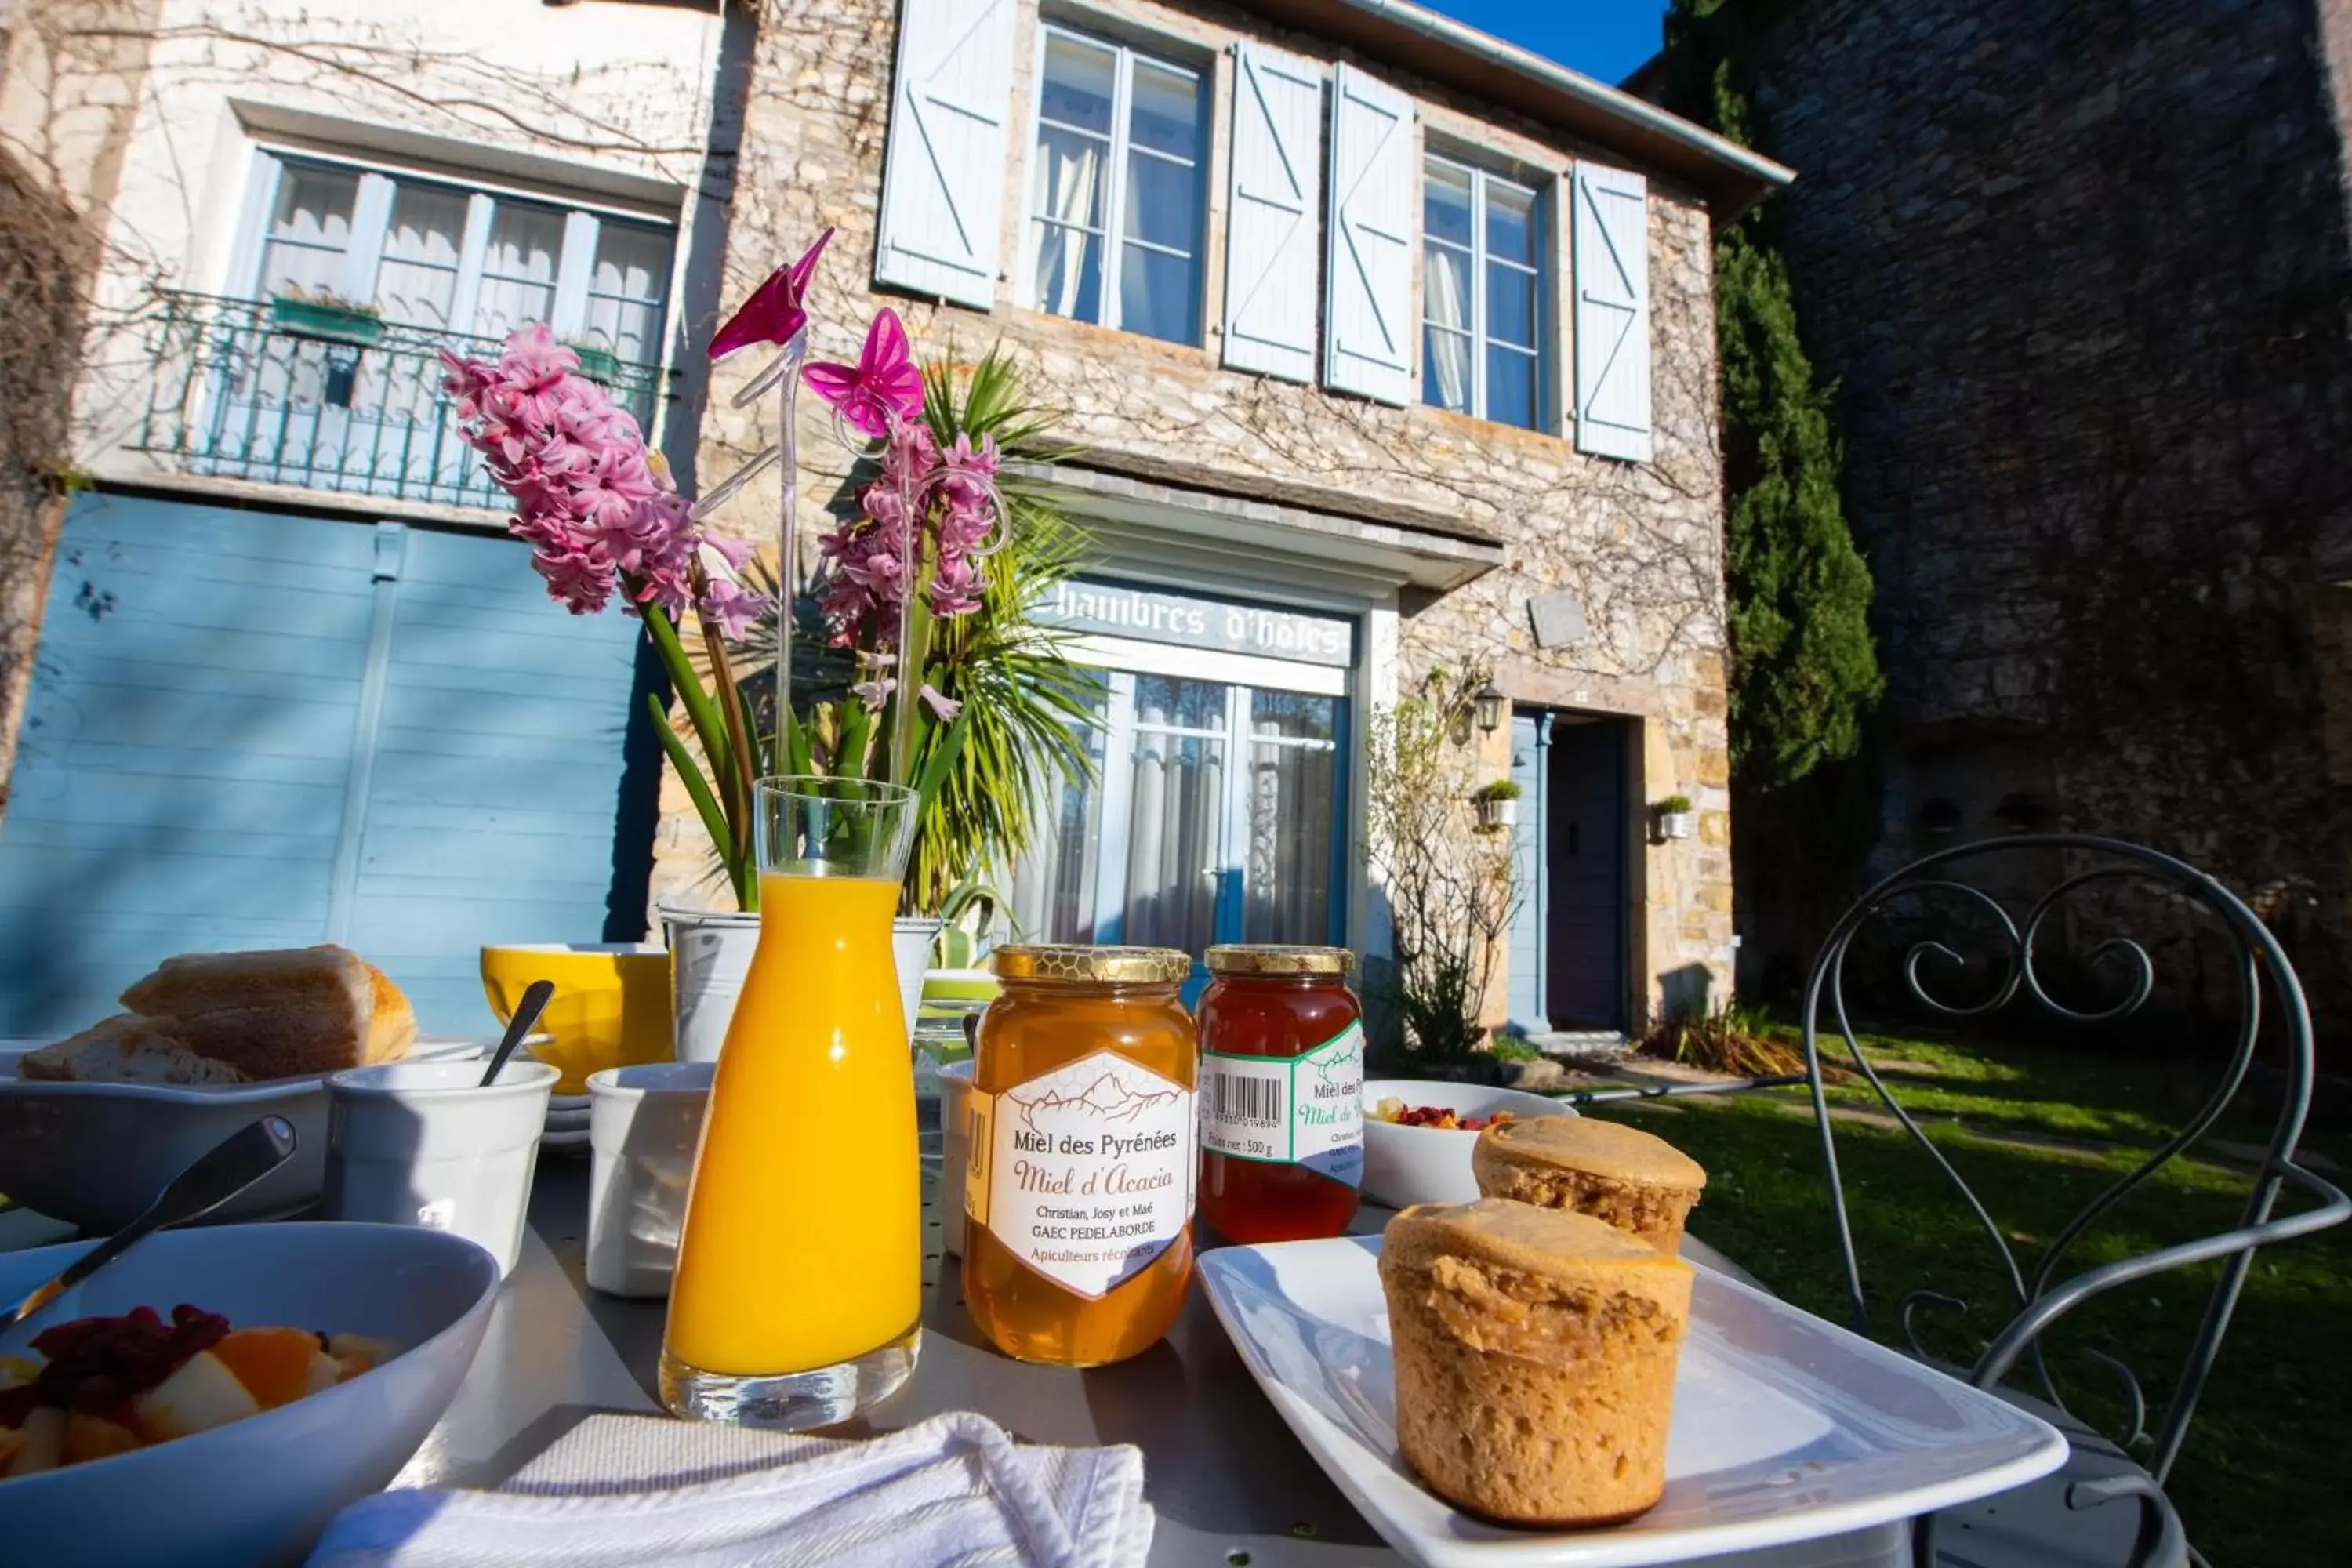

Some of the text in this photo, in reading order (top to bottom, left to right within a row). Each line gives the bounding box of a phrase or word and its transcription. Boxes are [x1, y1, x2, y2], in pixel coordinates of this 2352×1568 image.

[1313, 1083, 1340, 1098] Miel
[1298, 1103, 1338, 1125] Miel
[1014, 1130, 1176, 1159] Miel des Pyrénées
[1014, 1160, 1075, 1195] Miel
[1081, 1163, 1173, 1196] d'Acacia
[1036, 1201, 1153, 1223] Christian, Josy et Maé
[1032, 1220, 1155, 1240] GAEC PEDELABORDE
[1031, 1243, 1155, 1265] Apiculteurs récoants
